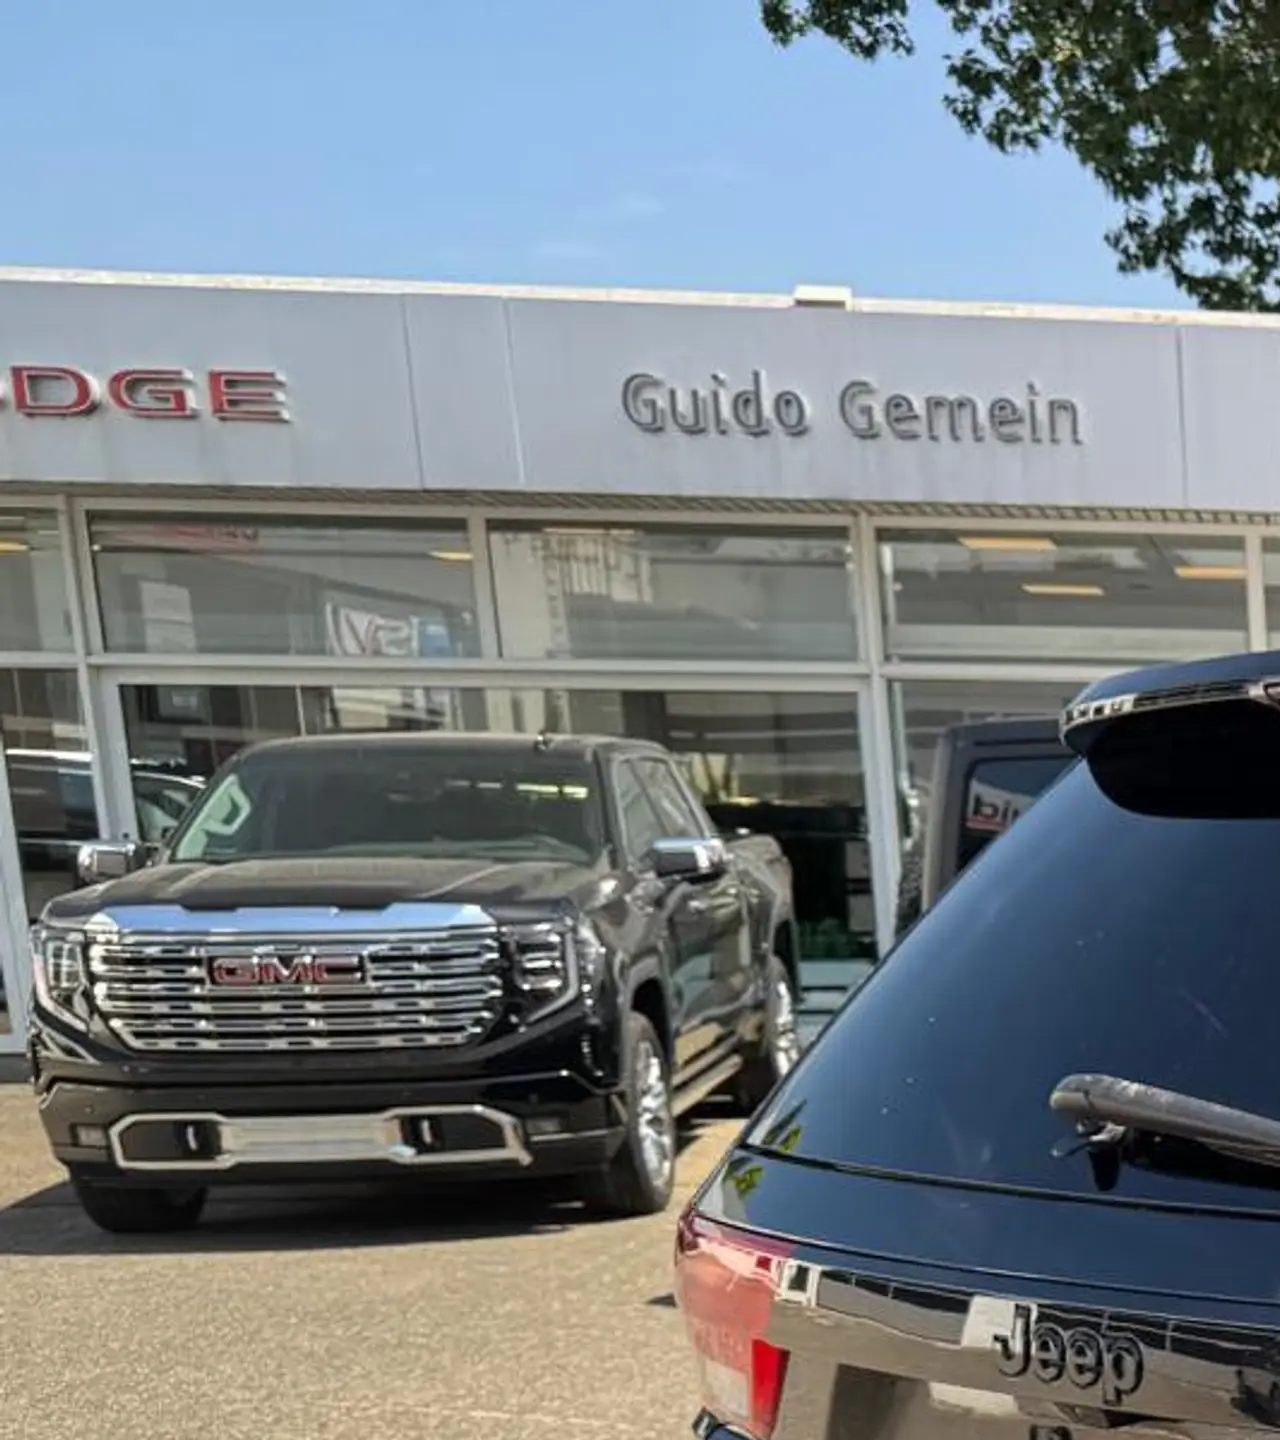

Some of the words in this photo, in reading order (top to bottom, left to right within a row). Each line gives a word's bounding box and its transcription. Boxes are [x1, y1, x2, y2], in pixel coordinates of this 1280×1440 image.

[0, 364, 290, 423] DGE
[621, 370, 811, 438] Guido
[839, 379, 1085, 446] Gemein
[212, 956, 362, 986] GMC
[992, 1302, 1144, 1405] Jeep
